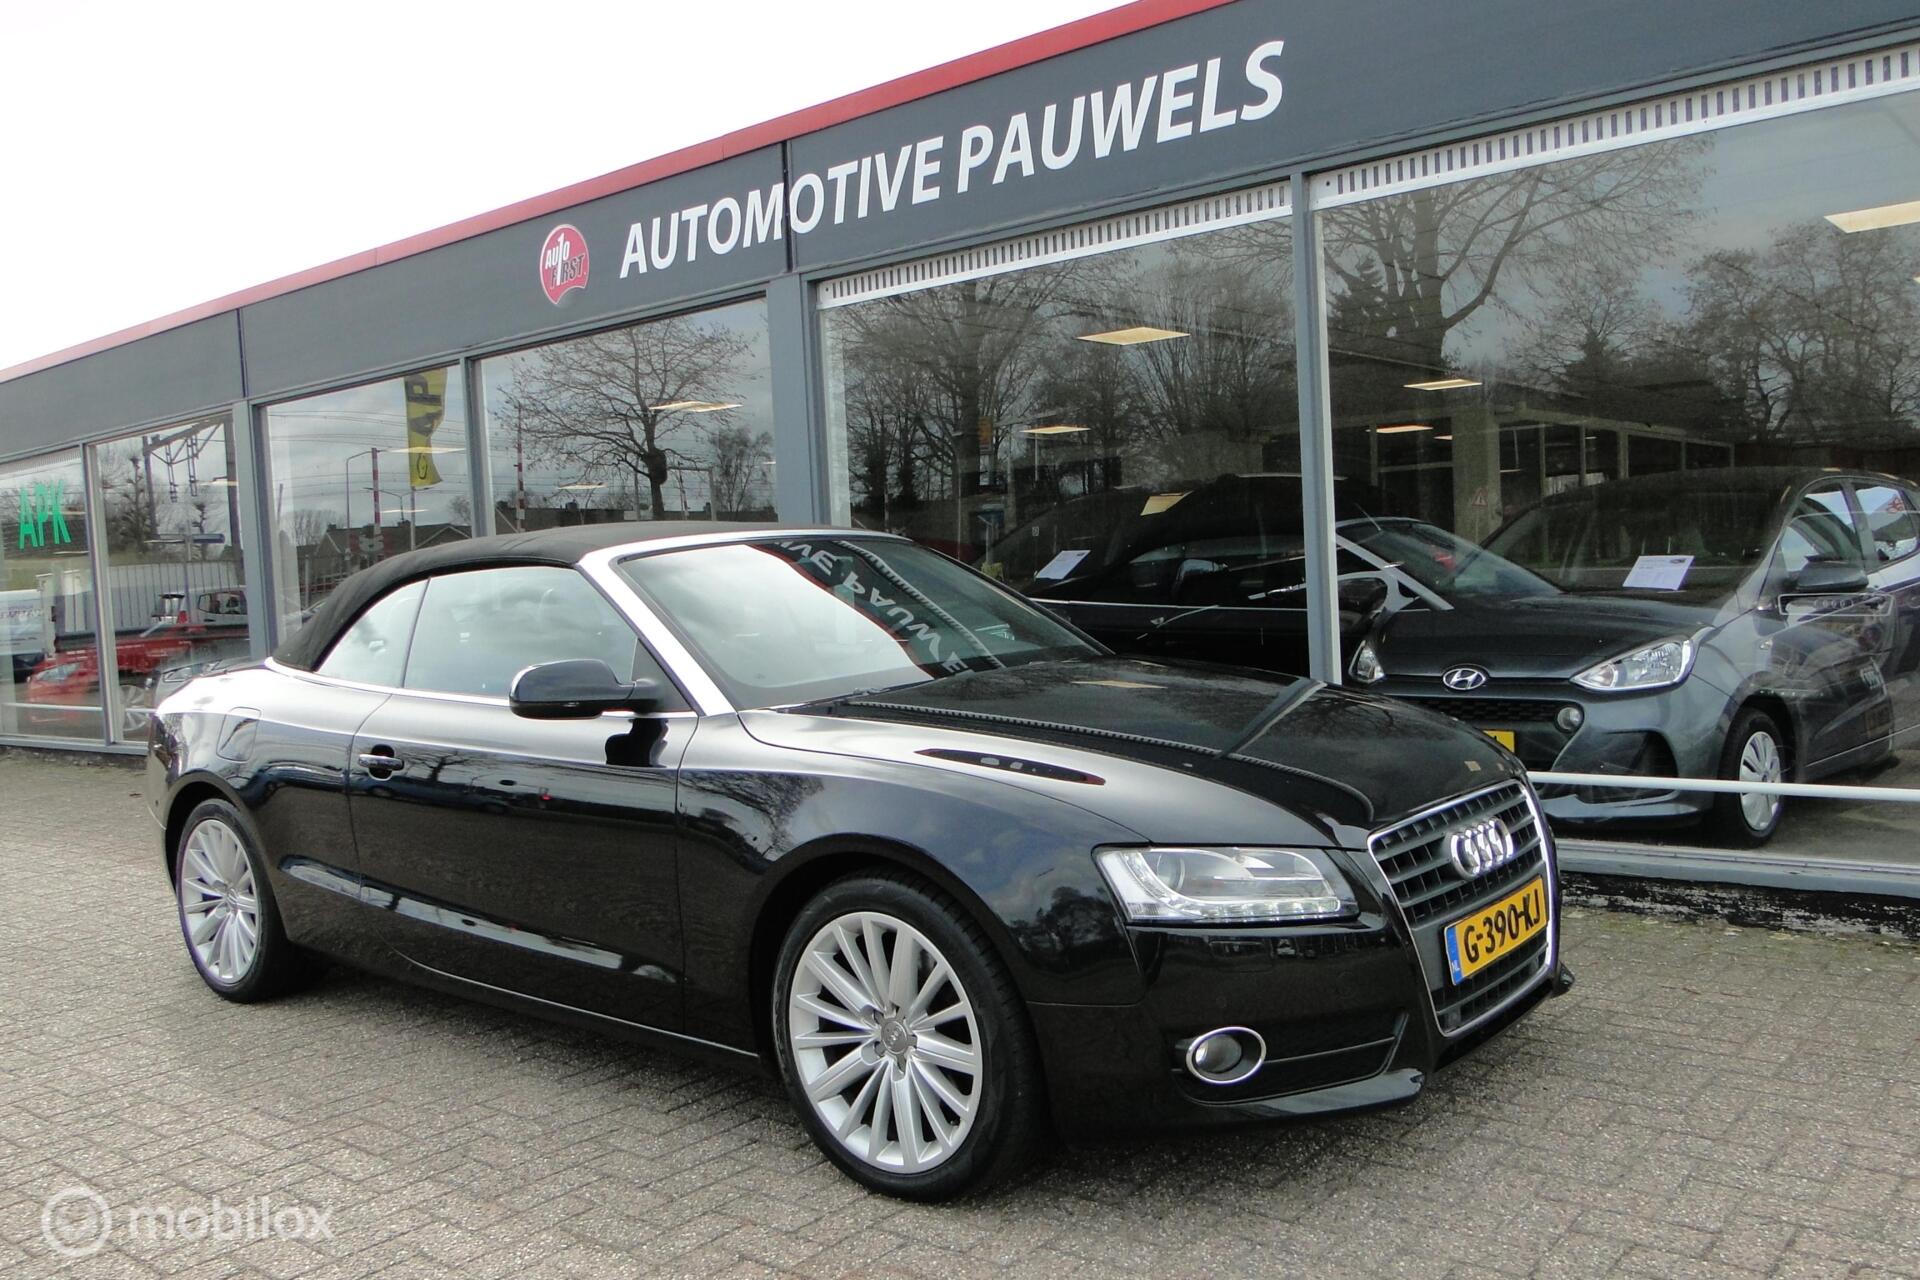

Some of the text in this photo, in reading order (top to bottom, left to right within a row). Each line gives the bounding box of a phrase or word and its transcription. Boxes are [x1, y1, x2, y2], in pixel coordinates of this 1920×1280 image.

[619, 40, 1285, 279] AUTOMOTIVE PAUWELS
[19, 478, 72, 550] APK
[1463, 888, 1541, 964] G-390-KJ
